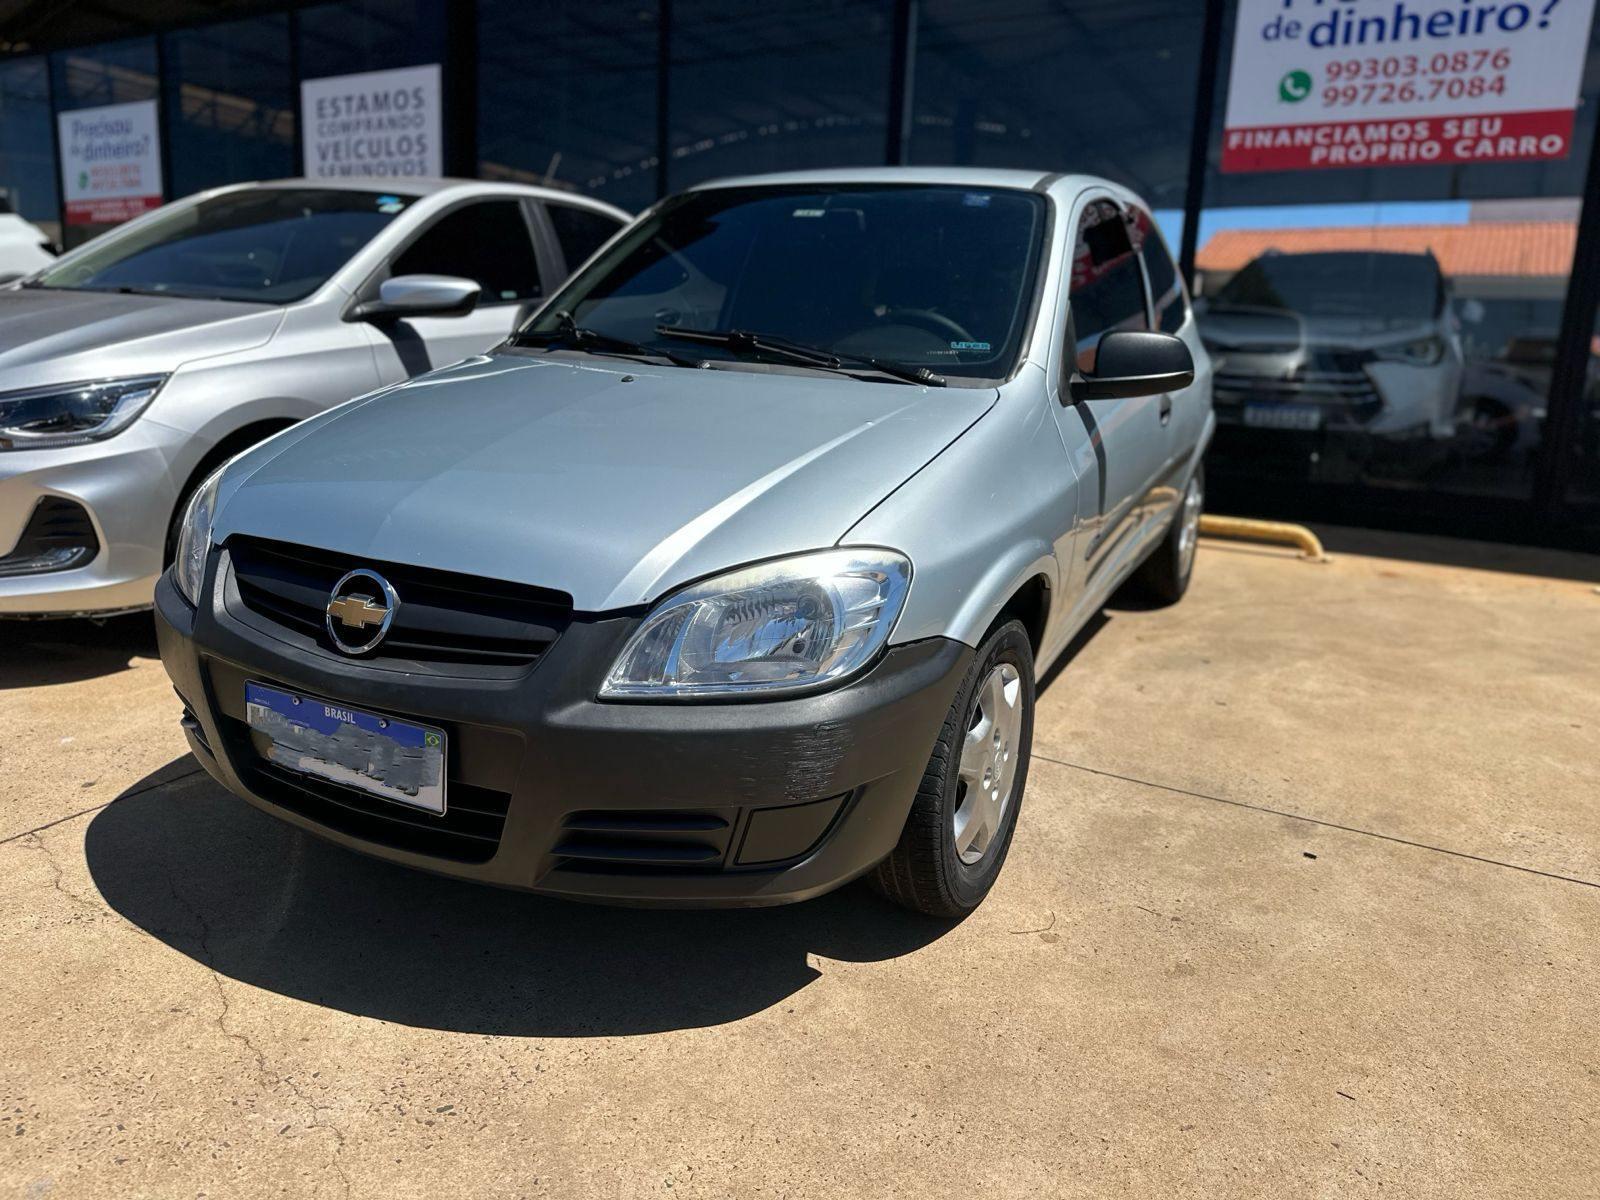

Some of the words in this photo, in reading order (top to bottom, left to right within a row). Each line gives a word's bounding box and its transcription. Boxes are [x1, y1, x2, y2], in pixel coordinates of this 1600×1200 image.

[1262, 15, 1302, 41] de
[1325, 48, 1511, 82] 99303.0876
[316, 86, 425, 119] ESTAMOS
[1322, 75, 1507, 107] 99726.7084
[317, 112, 426, 138] COMPRANDO
[1228, 121, 1430, 149] FINANCIAMOS
[1442, 117, 1503, 138] SEU
[1453, 134, 1564, 159] CARRO
[324, 706, 357, 725] BRASIL
